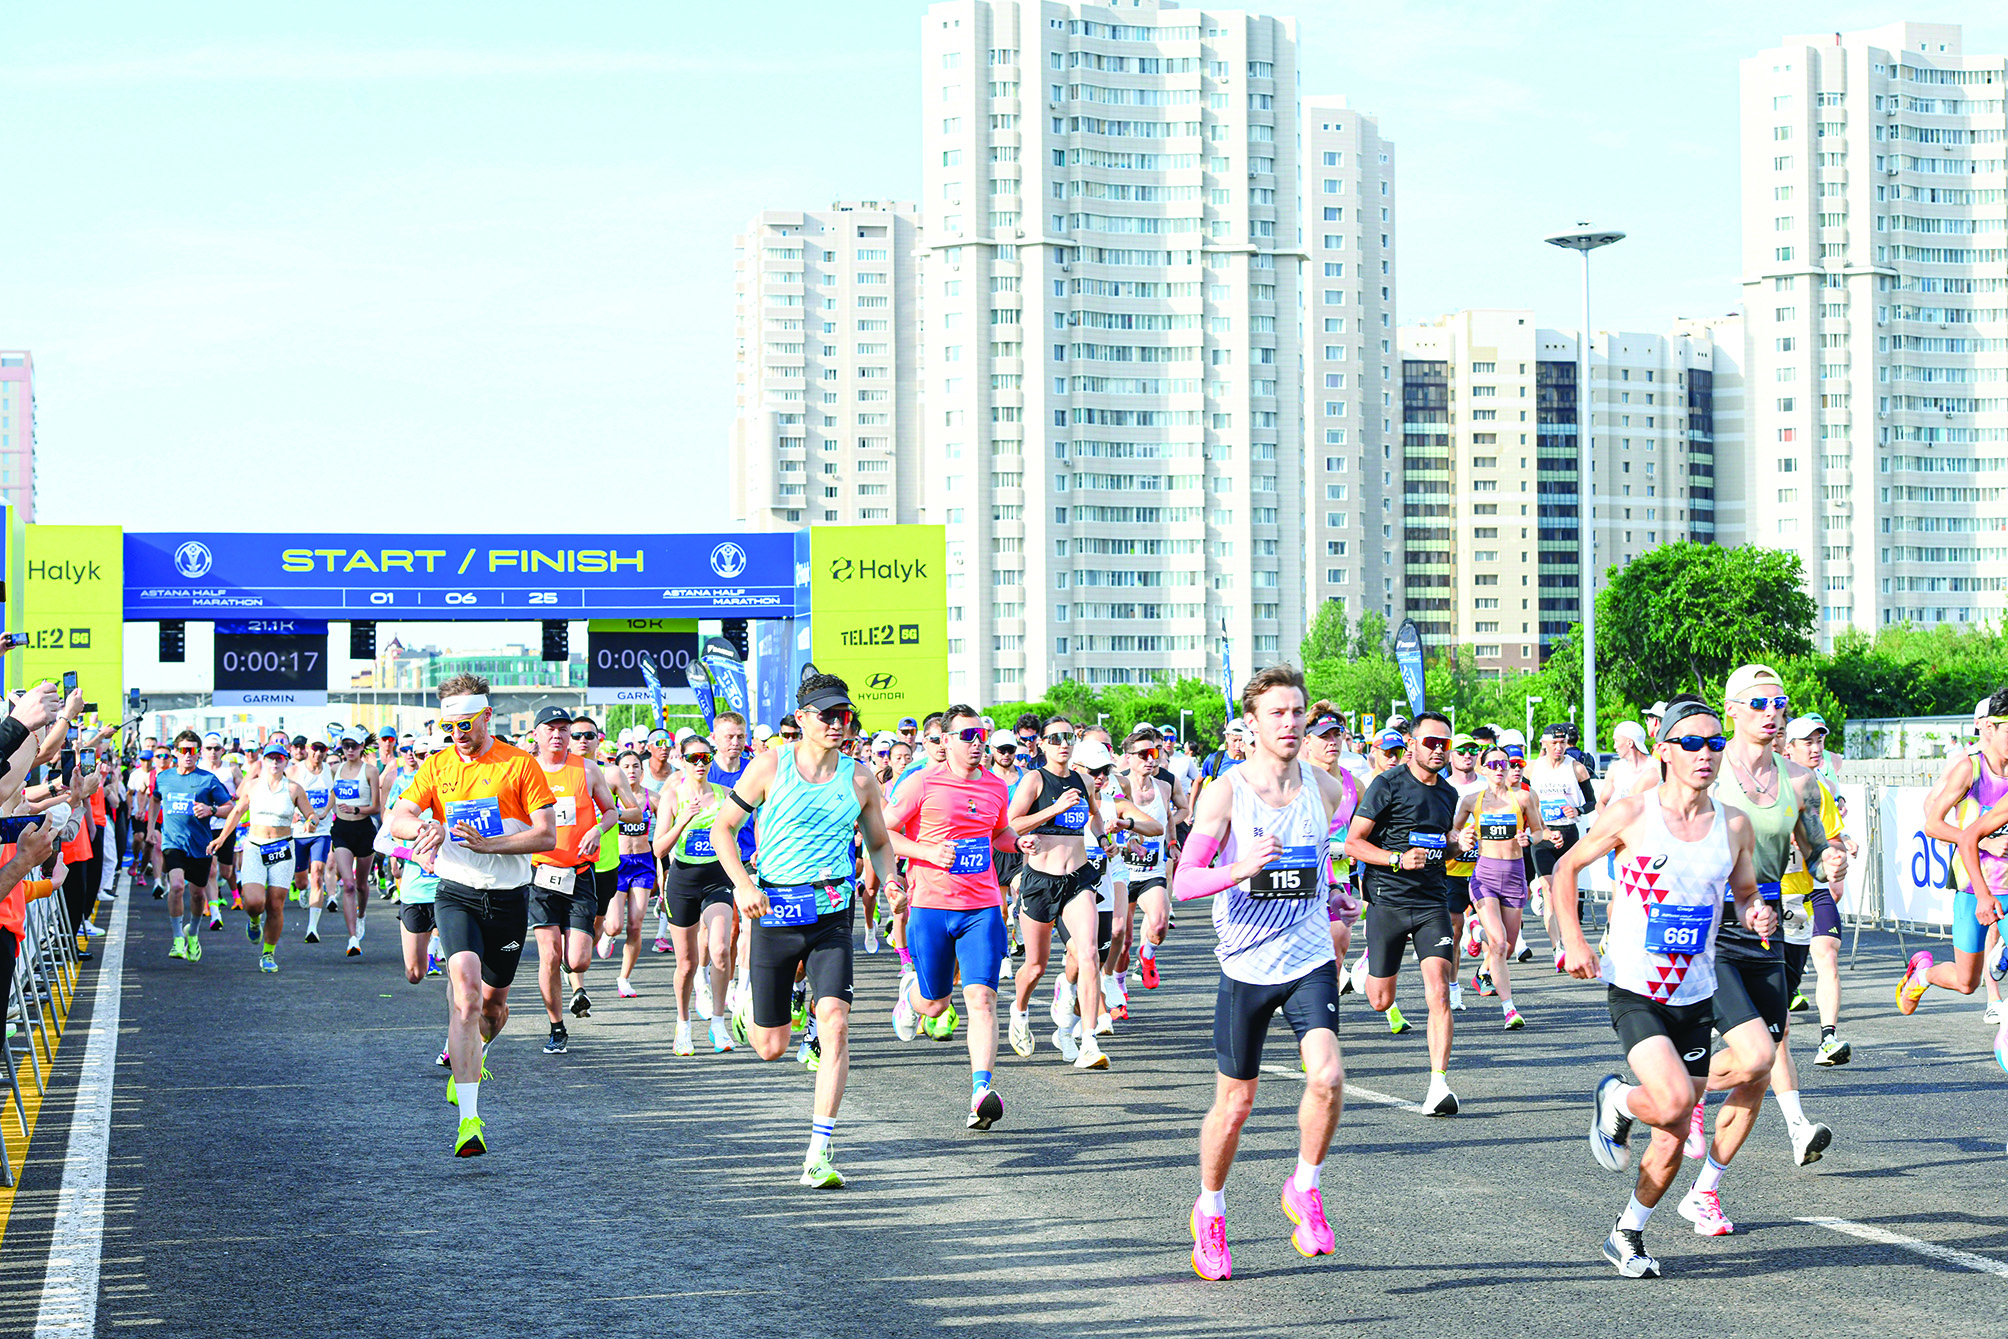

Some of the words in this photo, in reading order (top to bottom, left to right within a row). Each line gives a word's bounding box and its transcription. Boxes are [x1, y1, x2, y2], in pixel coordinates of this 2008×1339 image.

[281, 548, 446, 574] START
[489, 549, 644, 574] FINISH
[28, 560, 101, 585] Halyk
[860, 558, 928, 583] Halyk
[140, 589, 191, 597] ASTANA
[192, 589, 227, 597] HALF
[370, 592, 394, 605] 01
[445, 592, 477, 605] 06
[528, 592, 558, 605] 25
[662, 588, 711, 597] ASTANA
[713, 588, 746, 597] HALF
[193, 598, 263, 606] MARATHON
[713, 597, 781, 606] MARATHON
[840, 625, 895, 647] TELE2
[901, 630, 918, 642] 5G
[223, 651, 319, 673] 0:00:17
[242, 694, 295, 704] GARMIN
[617, 691, 667, 700] GARMN
[858, 692, 905, 700] HYUNDAI
[1063, 811, 1085, 824] 1519
[622, 822, 646, 833] 1008
[1490, 826, 1507, 836] 911
[960, 854, 984, 867] 472
[549, 875, 562, 886] E1
[1269, 870, 1301, 889] 115
[773, 904, 802, 919] 921
[1650, 908, 1660, 918] B
[1664, 926, 1699, 945] 661
